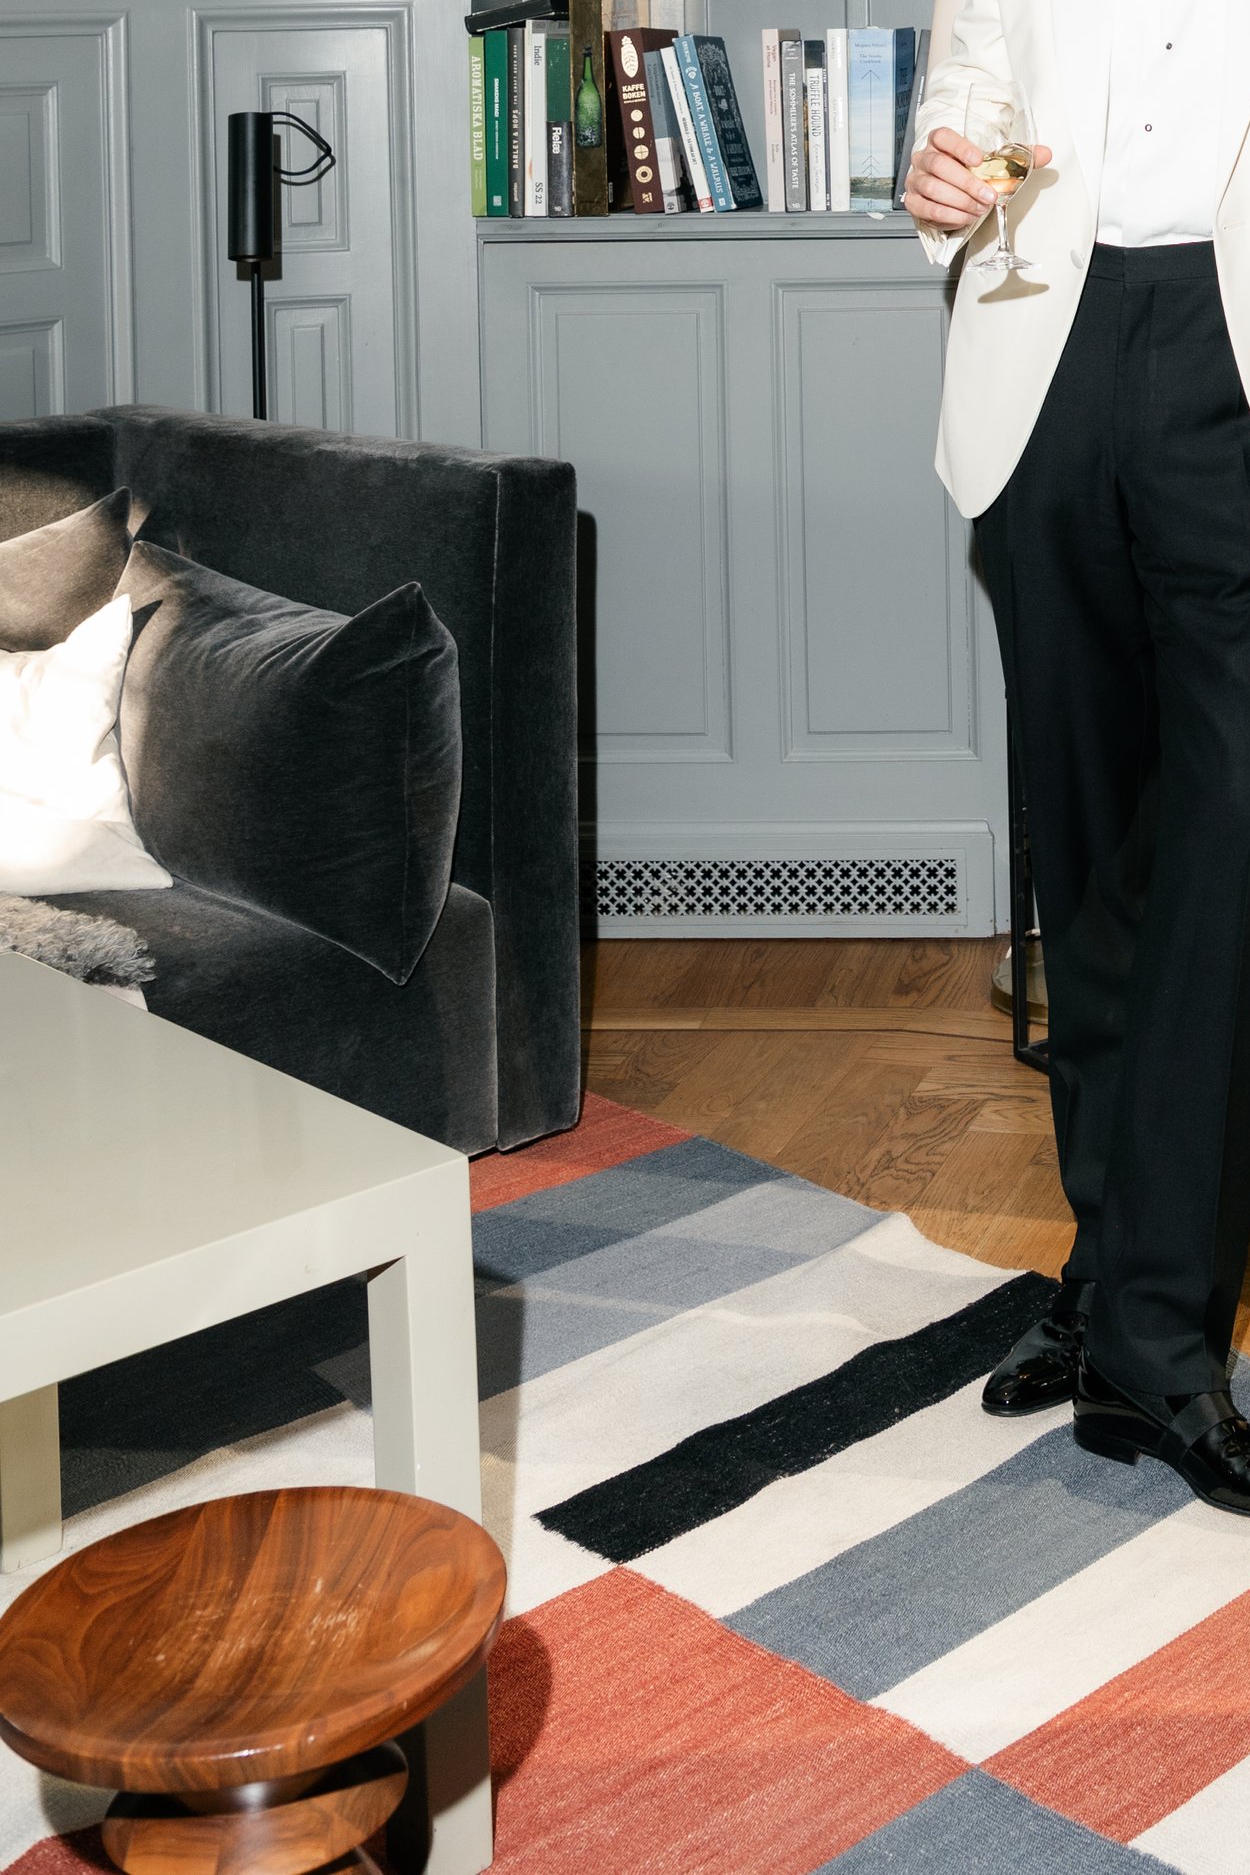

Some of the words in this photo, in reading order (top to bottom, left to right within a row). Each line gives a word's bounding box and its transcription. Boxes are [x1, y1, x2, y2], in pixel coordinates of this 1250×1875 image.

[533, 45, 541, 66] Indie
[471, 55, 483, 127] AROMATISKA
[622, 83, 645, 93] KAFFE
[622, 91, 646, 100] BOKEN
[809, 75, 821, 107] TRUFFLE
[789, 88, 797, 132] SOMMELIER'S
[811, 109, 822, 137] HOUND
[473, 128, 484, 161] BLAD
[552, 126, 562, 155] Relæ
[699, 119, 712, 147] WHALE
[708, 162, 724, 194] WALRUS
[791, 157, 798, 167] OF
[535, 182, 543, 193] SS
[535, 194, 543, 205] 22
